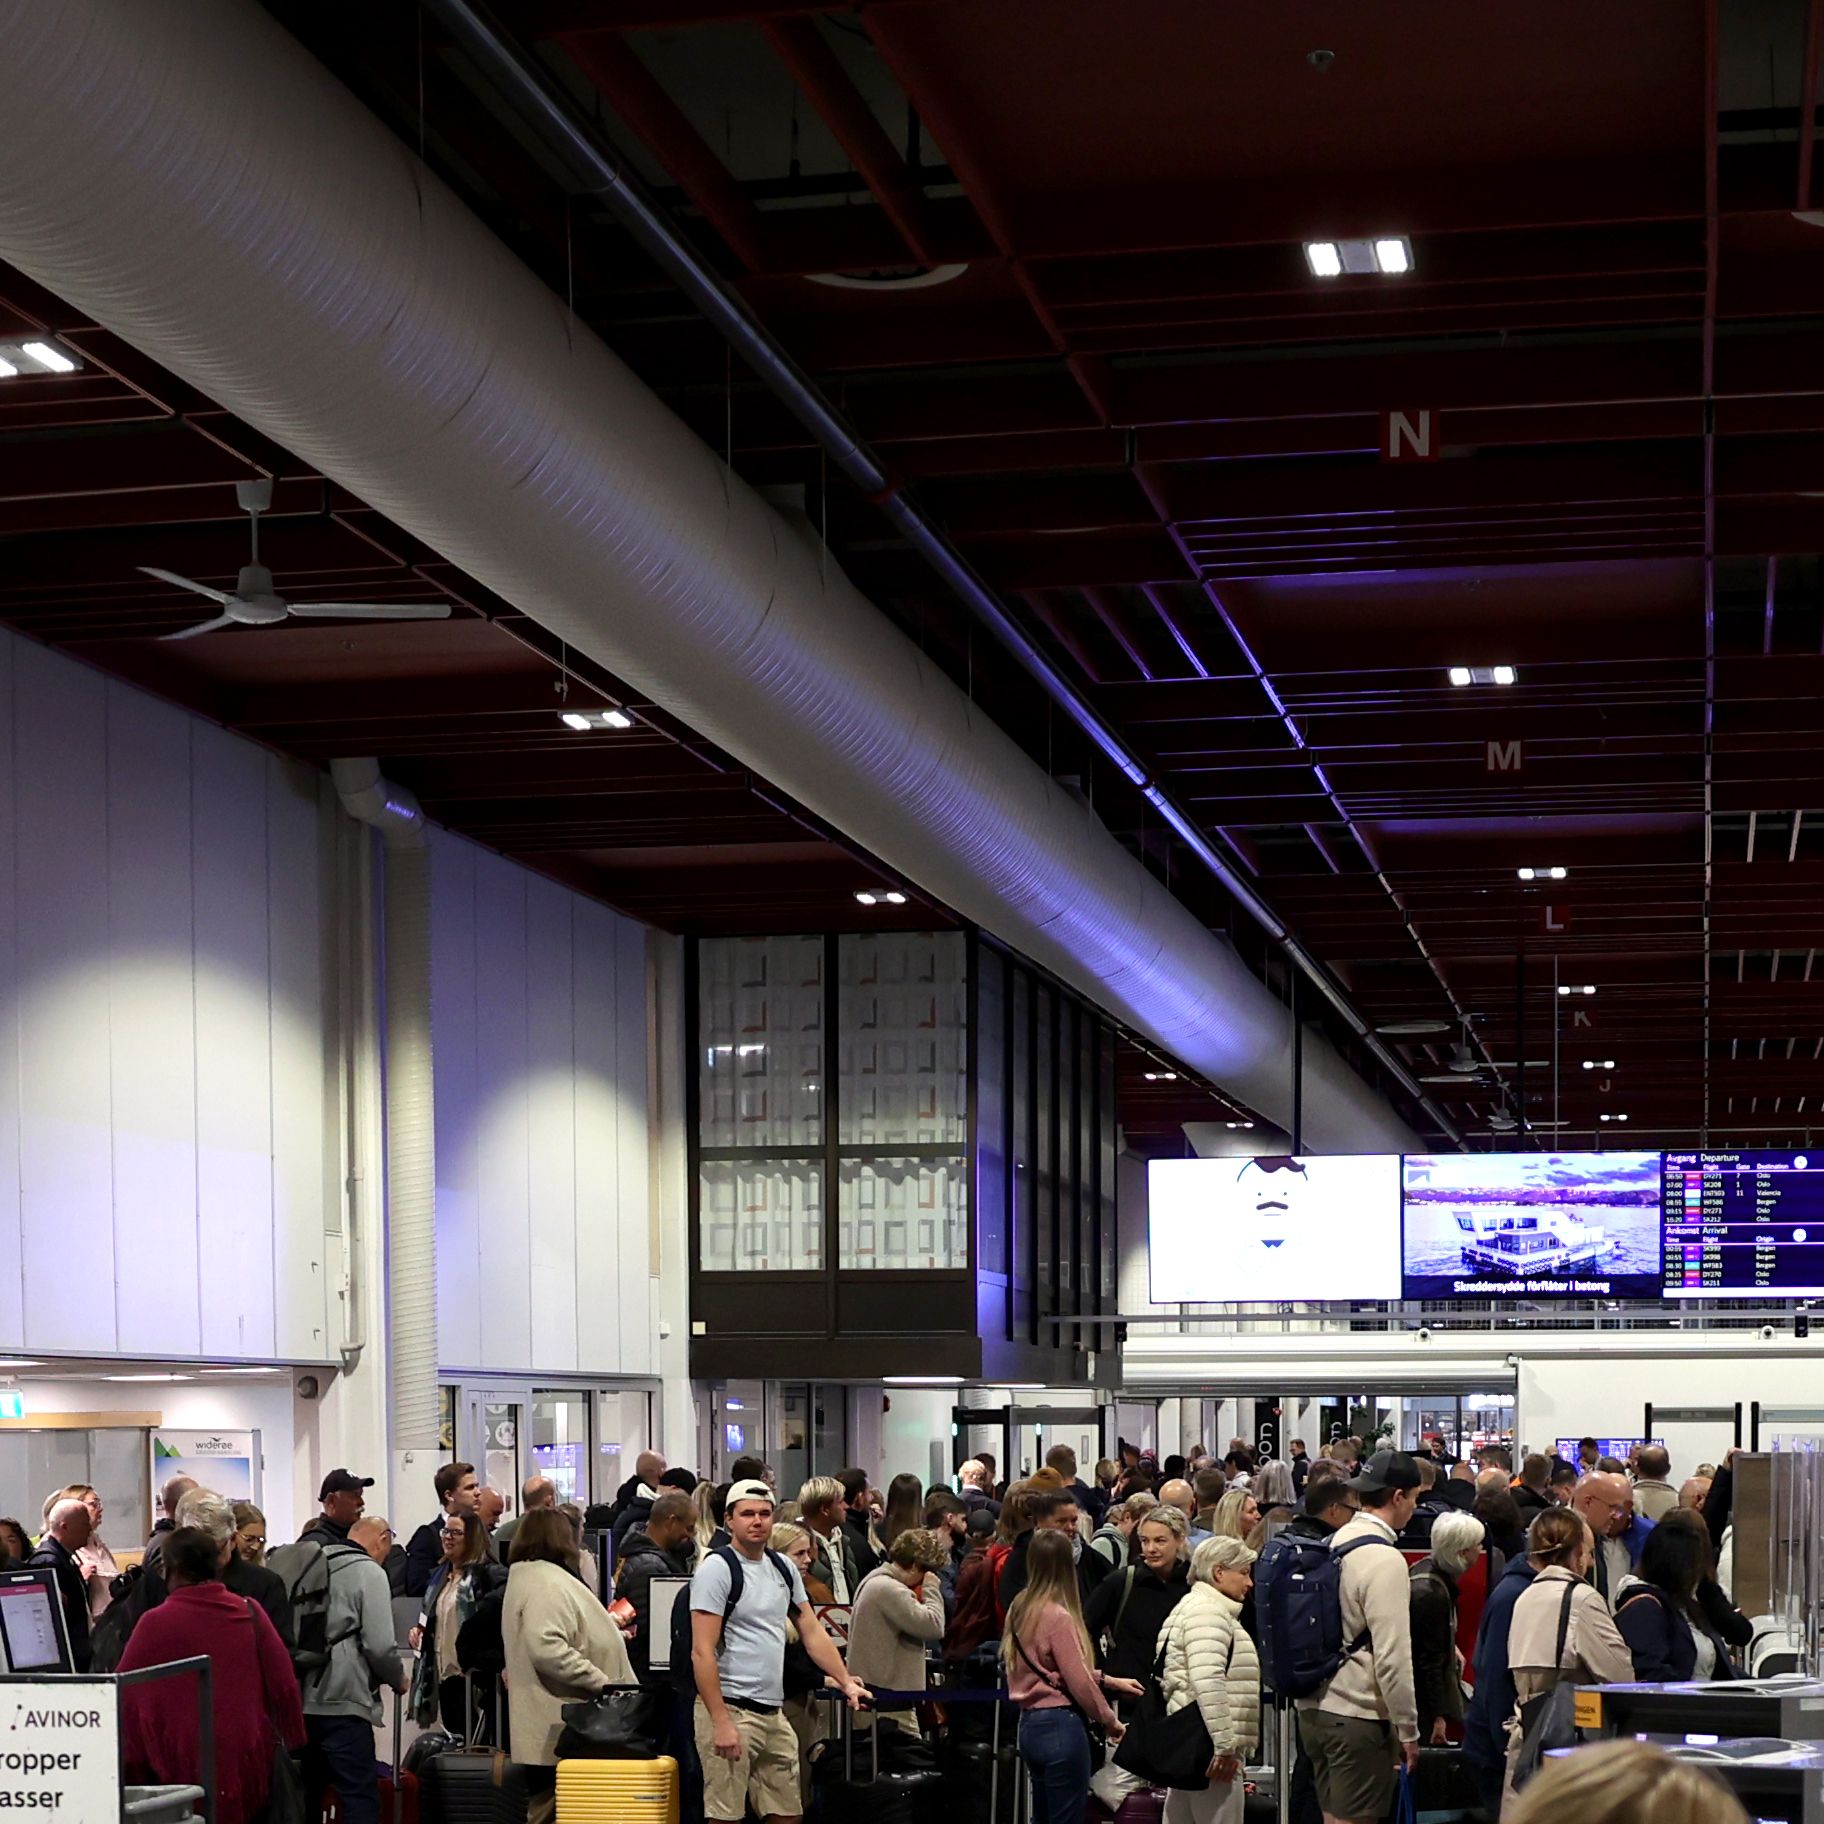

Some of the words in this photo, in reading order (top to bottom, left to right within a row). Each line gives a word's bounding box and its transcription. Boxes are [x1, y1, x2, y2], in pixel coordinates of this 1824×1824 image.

[1388, 410, 1431, 458] N
[1487, 741, 1522, 770] M
[1546, 906, 1564, 929] L
[1574, 1011, 1592, 1027] K
[1599, 1079, 1611, 1092] J
[1701, 1154, 1739, 1162] Departure
[1666, 1227, 1699, 1235] Ankomst
[1703, 1226, 1728, 1234] Arrival
[1575, 1281, 1610, 1293] betong
[25, 1711, 101, 1728] AVINOR
